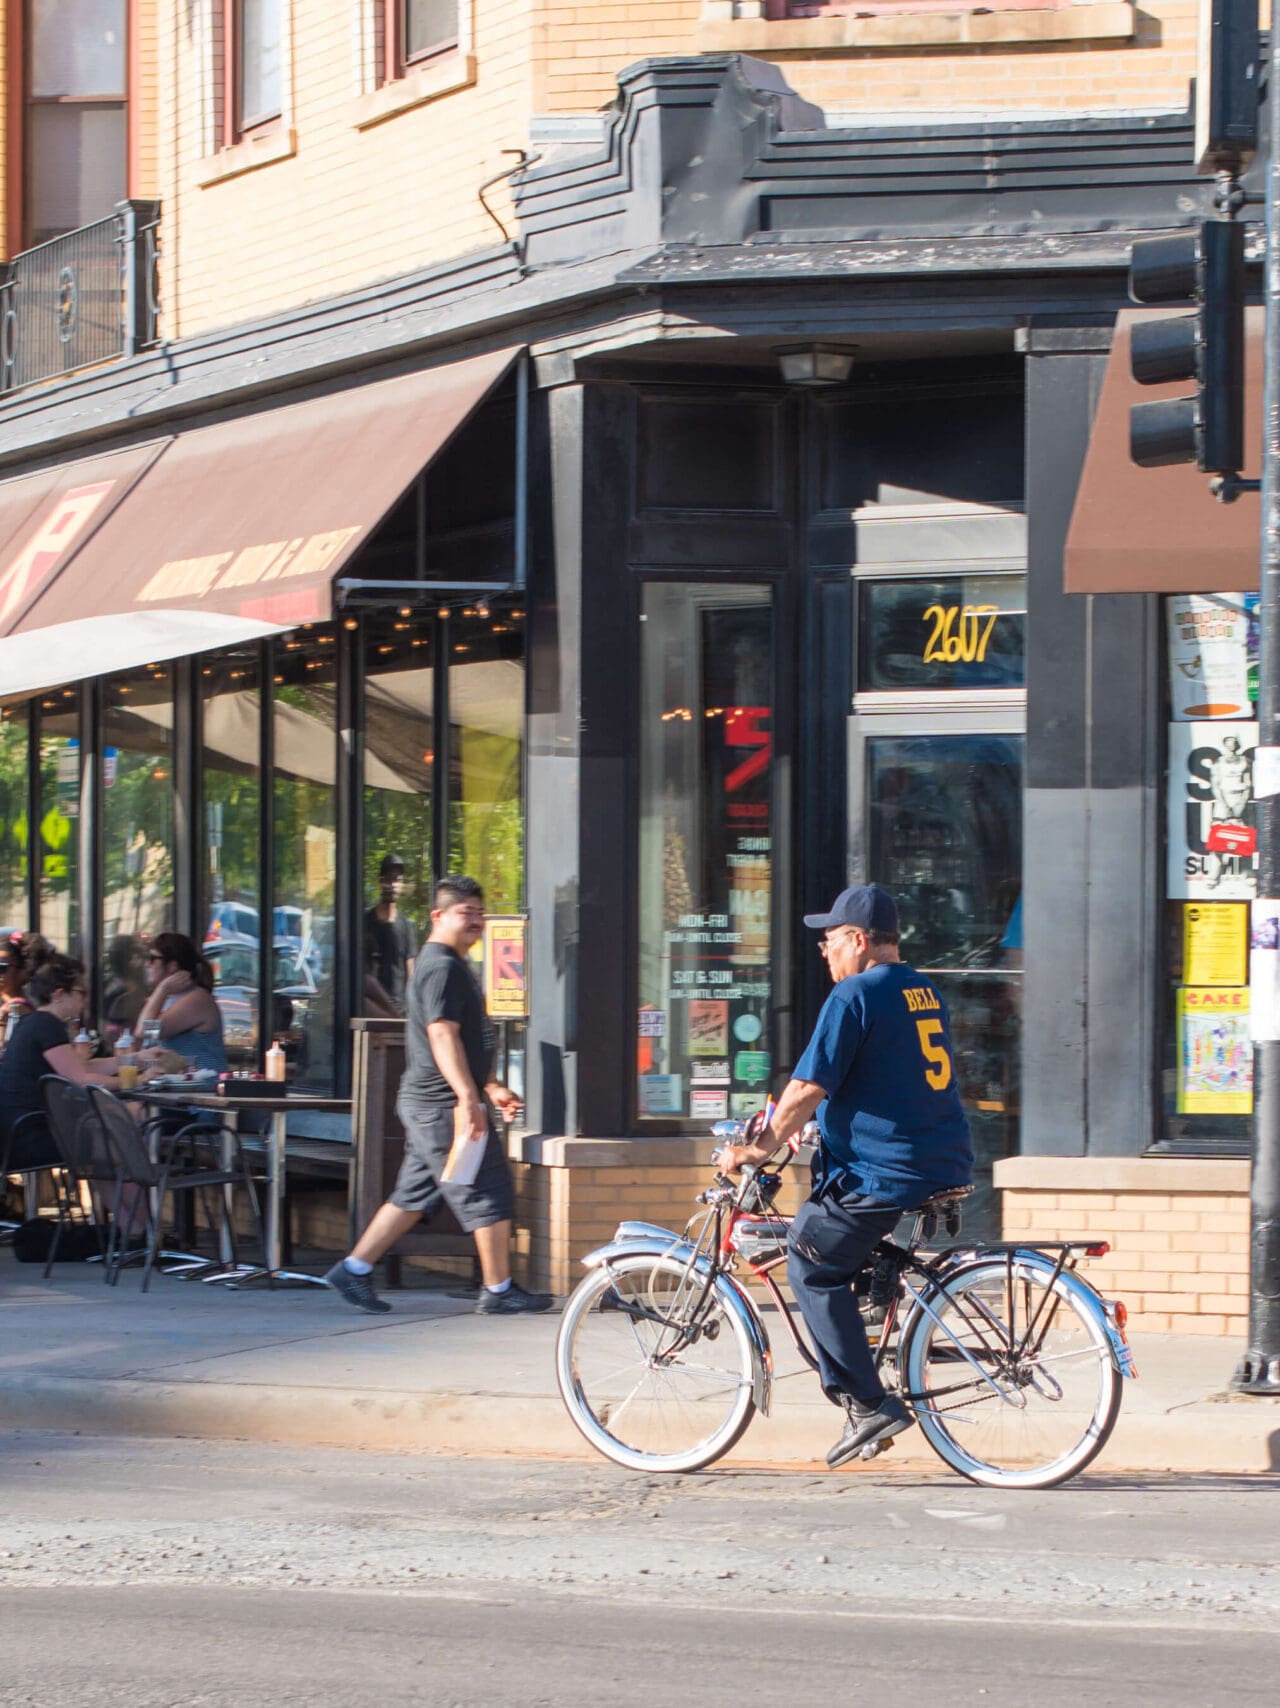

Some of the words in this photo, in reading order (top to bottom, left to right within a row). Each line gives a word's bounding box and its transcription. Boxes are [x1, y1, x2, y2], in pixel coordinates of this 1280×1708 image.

[922, 604, 999, 664] 2607
[708, 970, 733, 984] SUN
[902, 986, 941, 1012] BELL
[1186, 993, 1243, 1005] CAKE
[915, 1018, 952, 1090] 5
